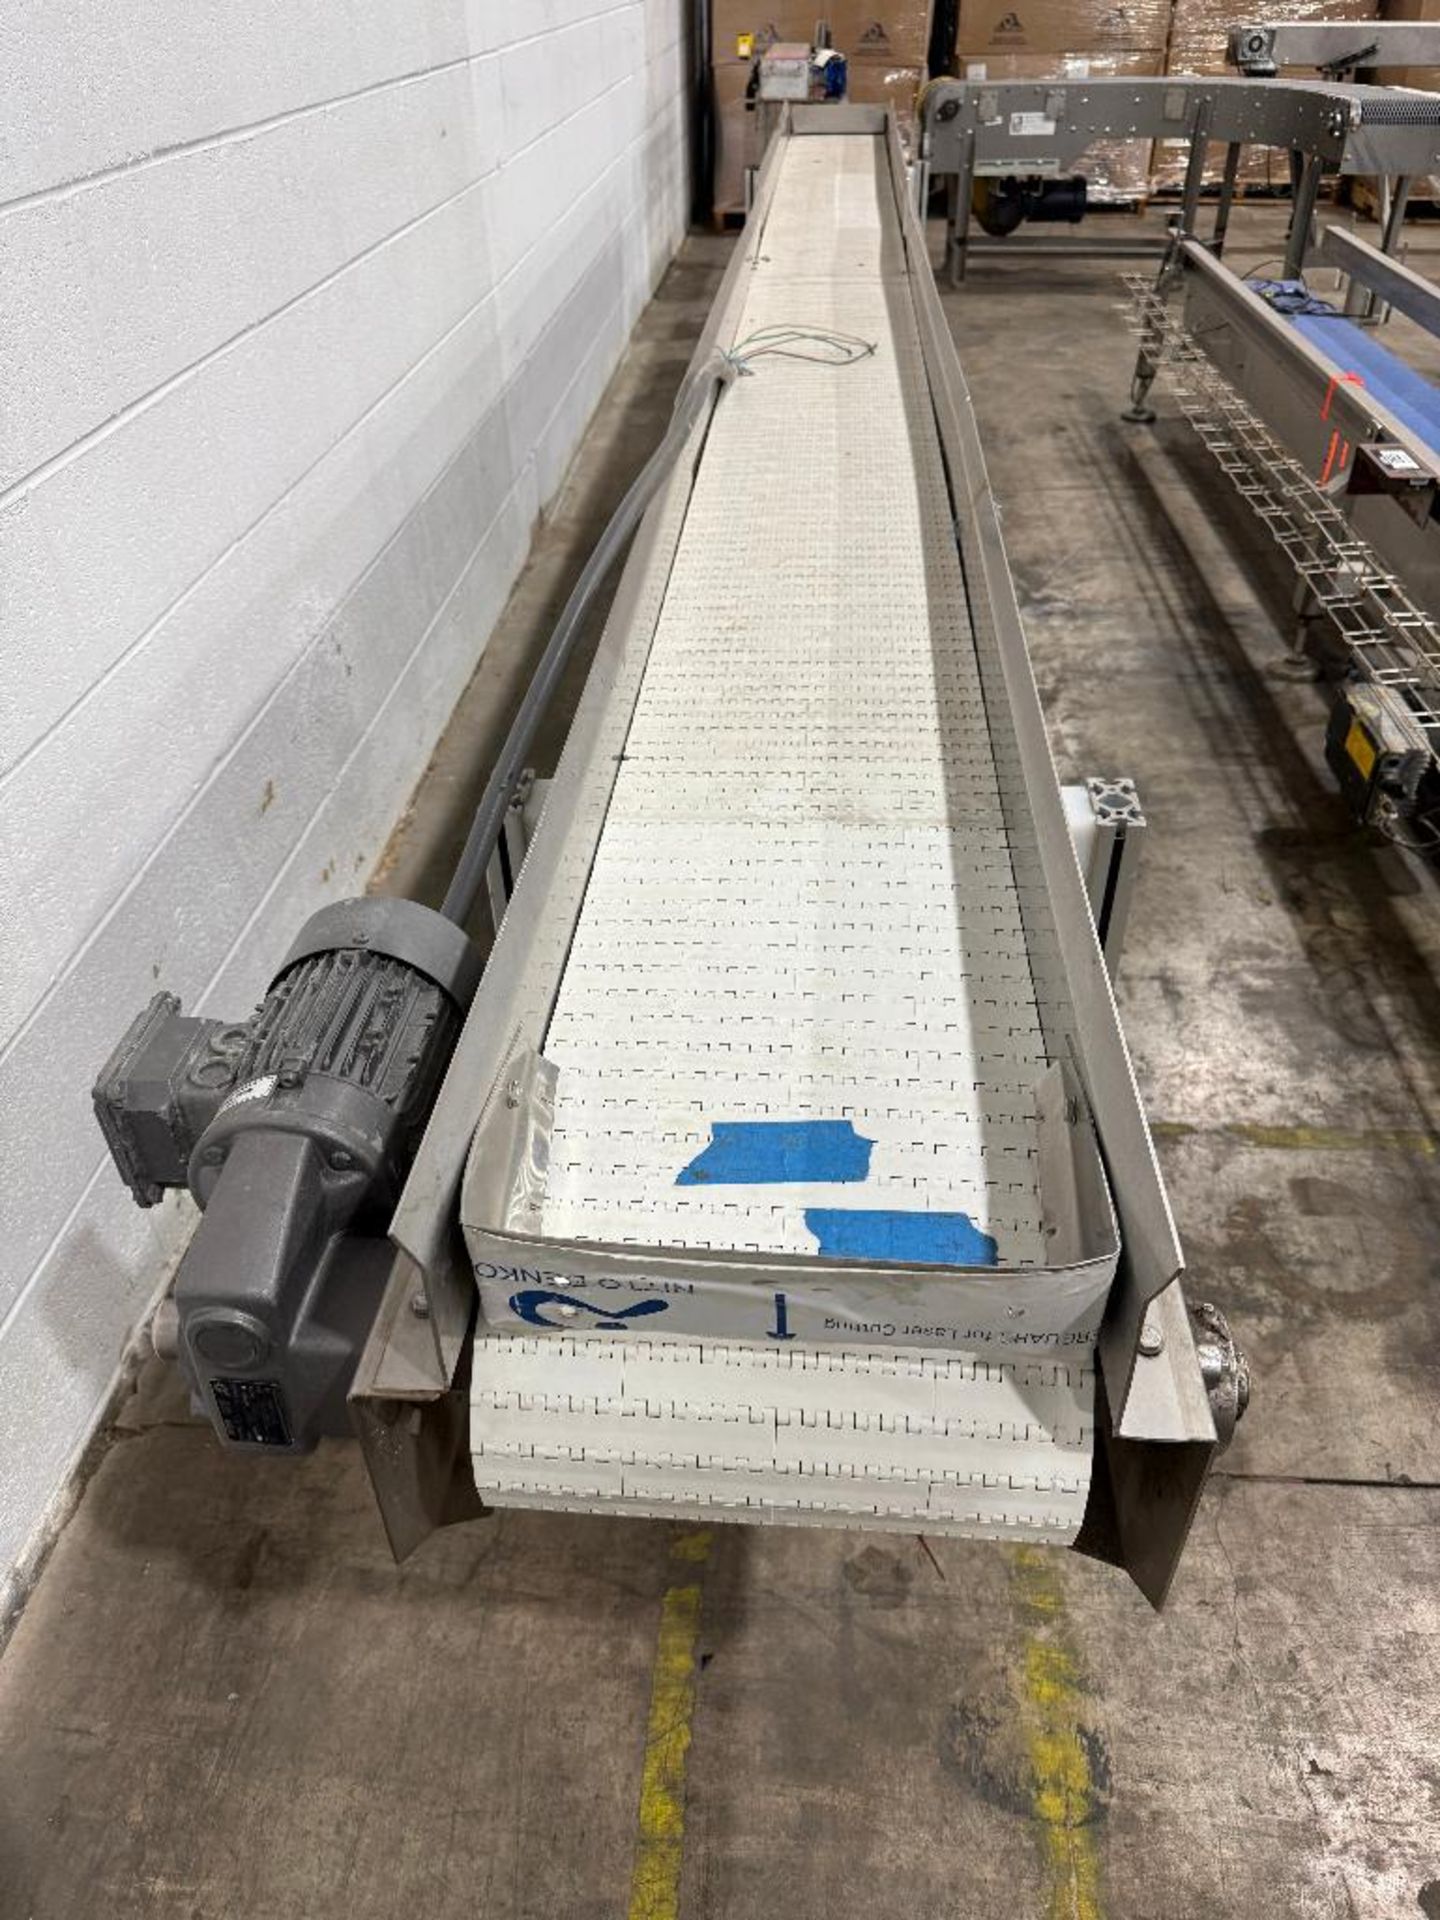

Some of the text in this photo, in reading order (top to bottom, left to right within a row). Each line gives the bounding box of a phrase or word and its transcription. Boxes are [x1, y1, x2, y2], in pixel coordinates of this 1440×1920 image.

[599, 1278, 695, 1294] NITTO
[825, 1317, 897, 1337] Cutting
[902, 1324, 957, 1341] Laser
[963, 1329, 993, 1342] for
